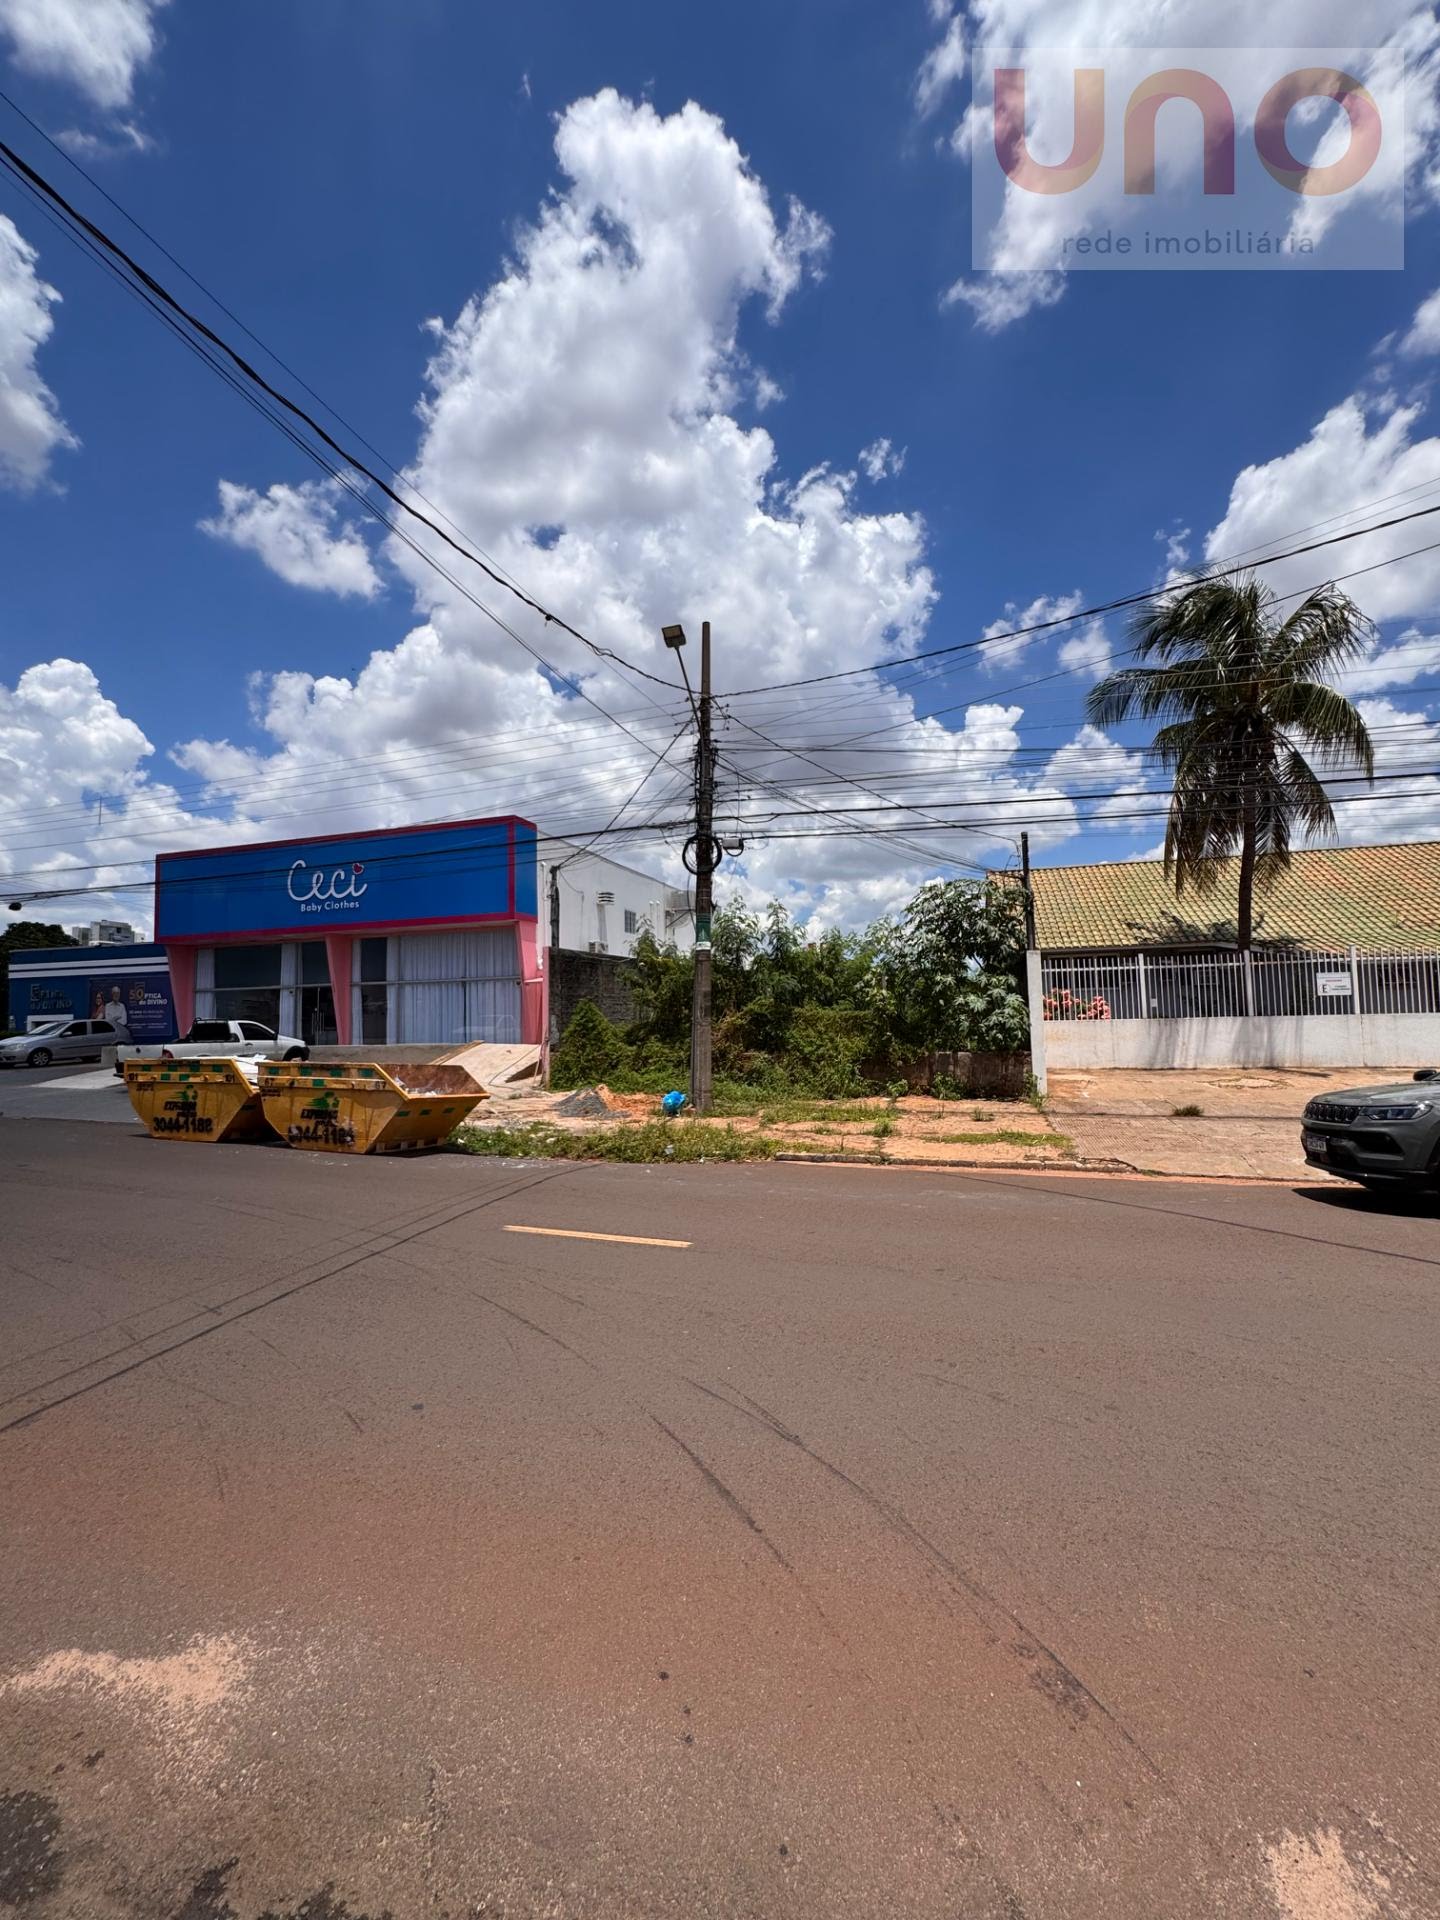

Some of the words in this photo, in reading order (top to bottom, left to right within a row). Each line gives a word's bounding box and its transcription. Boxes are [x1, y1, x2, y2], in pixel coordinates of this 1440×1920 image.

[287, 859, 368, 901] Ceci
[300, 902, 323, 913] Baby
[324, 899, 360, 911] Clothes
